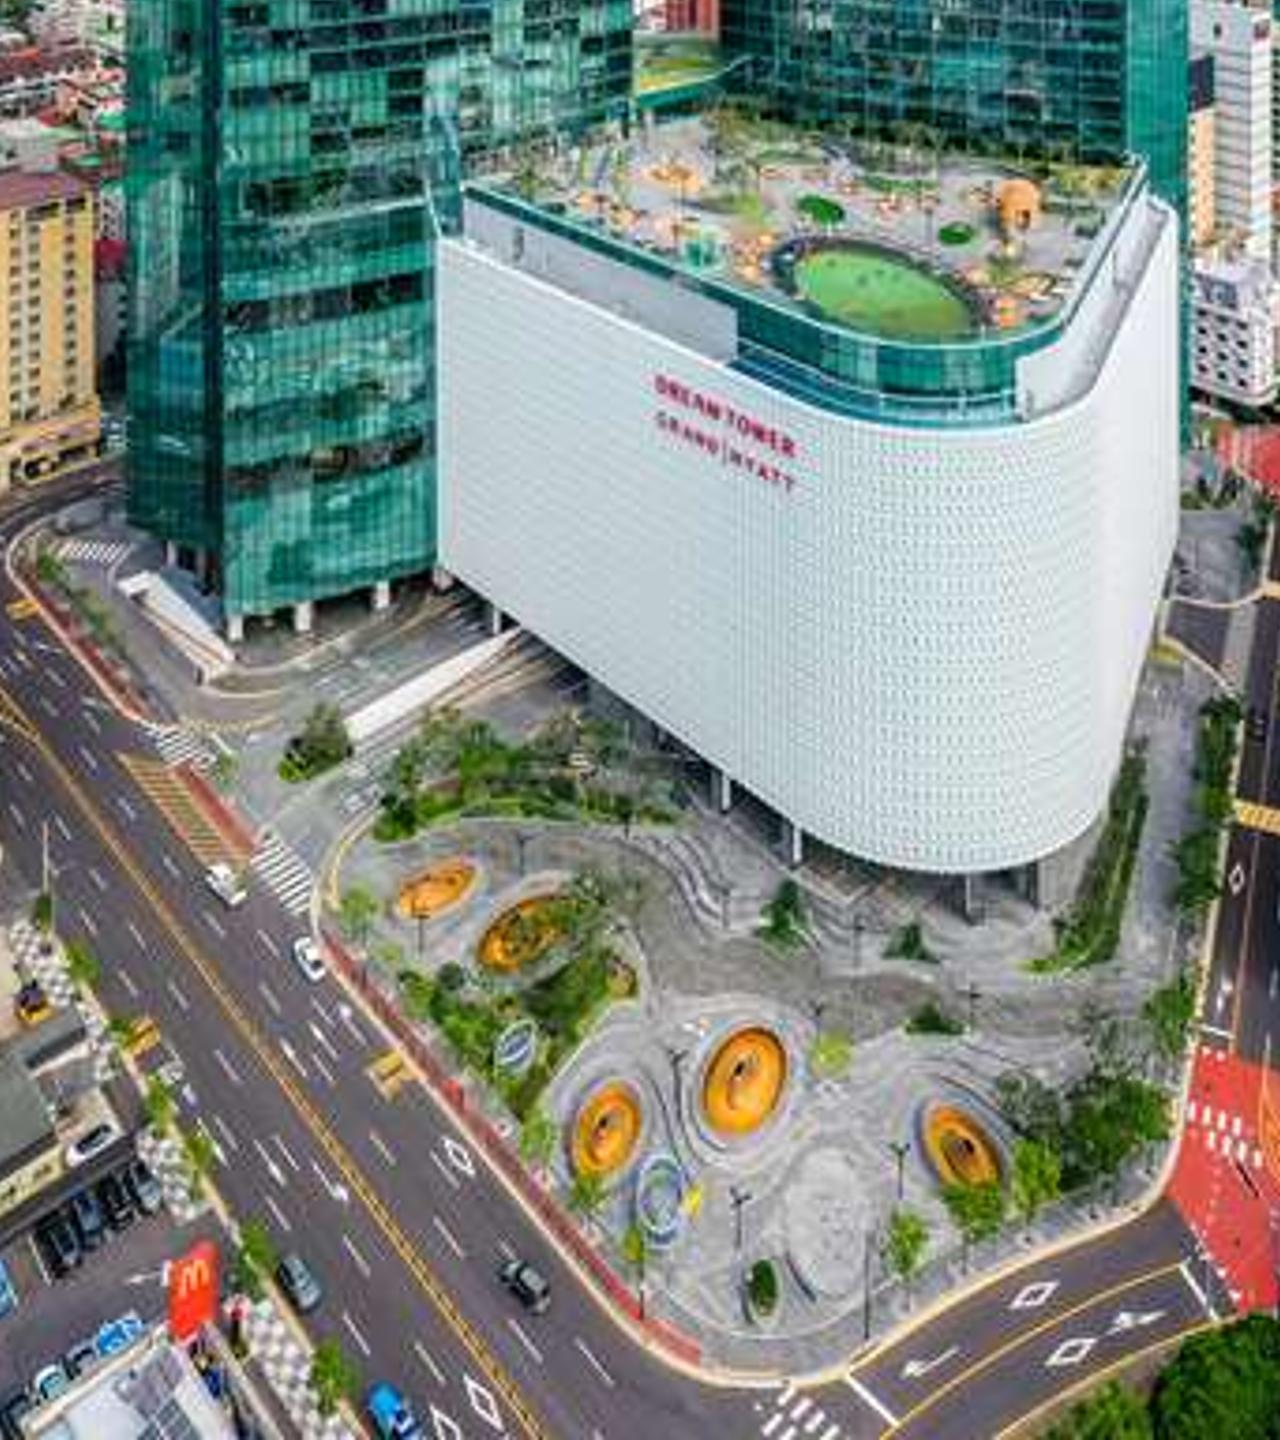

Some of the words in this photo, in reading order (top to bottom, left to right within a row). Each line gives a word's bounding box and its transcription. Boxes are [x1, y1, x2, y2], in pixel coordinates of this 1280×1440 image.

[654, 374, 720, 420] DREAM
[727, 408, 796, 458] TOWER
[656, 410, 720, 456] GRAND
[729, 447, 796, 494] HYATT
